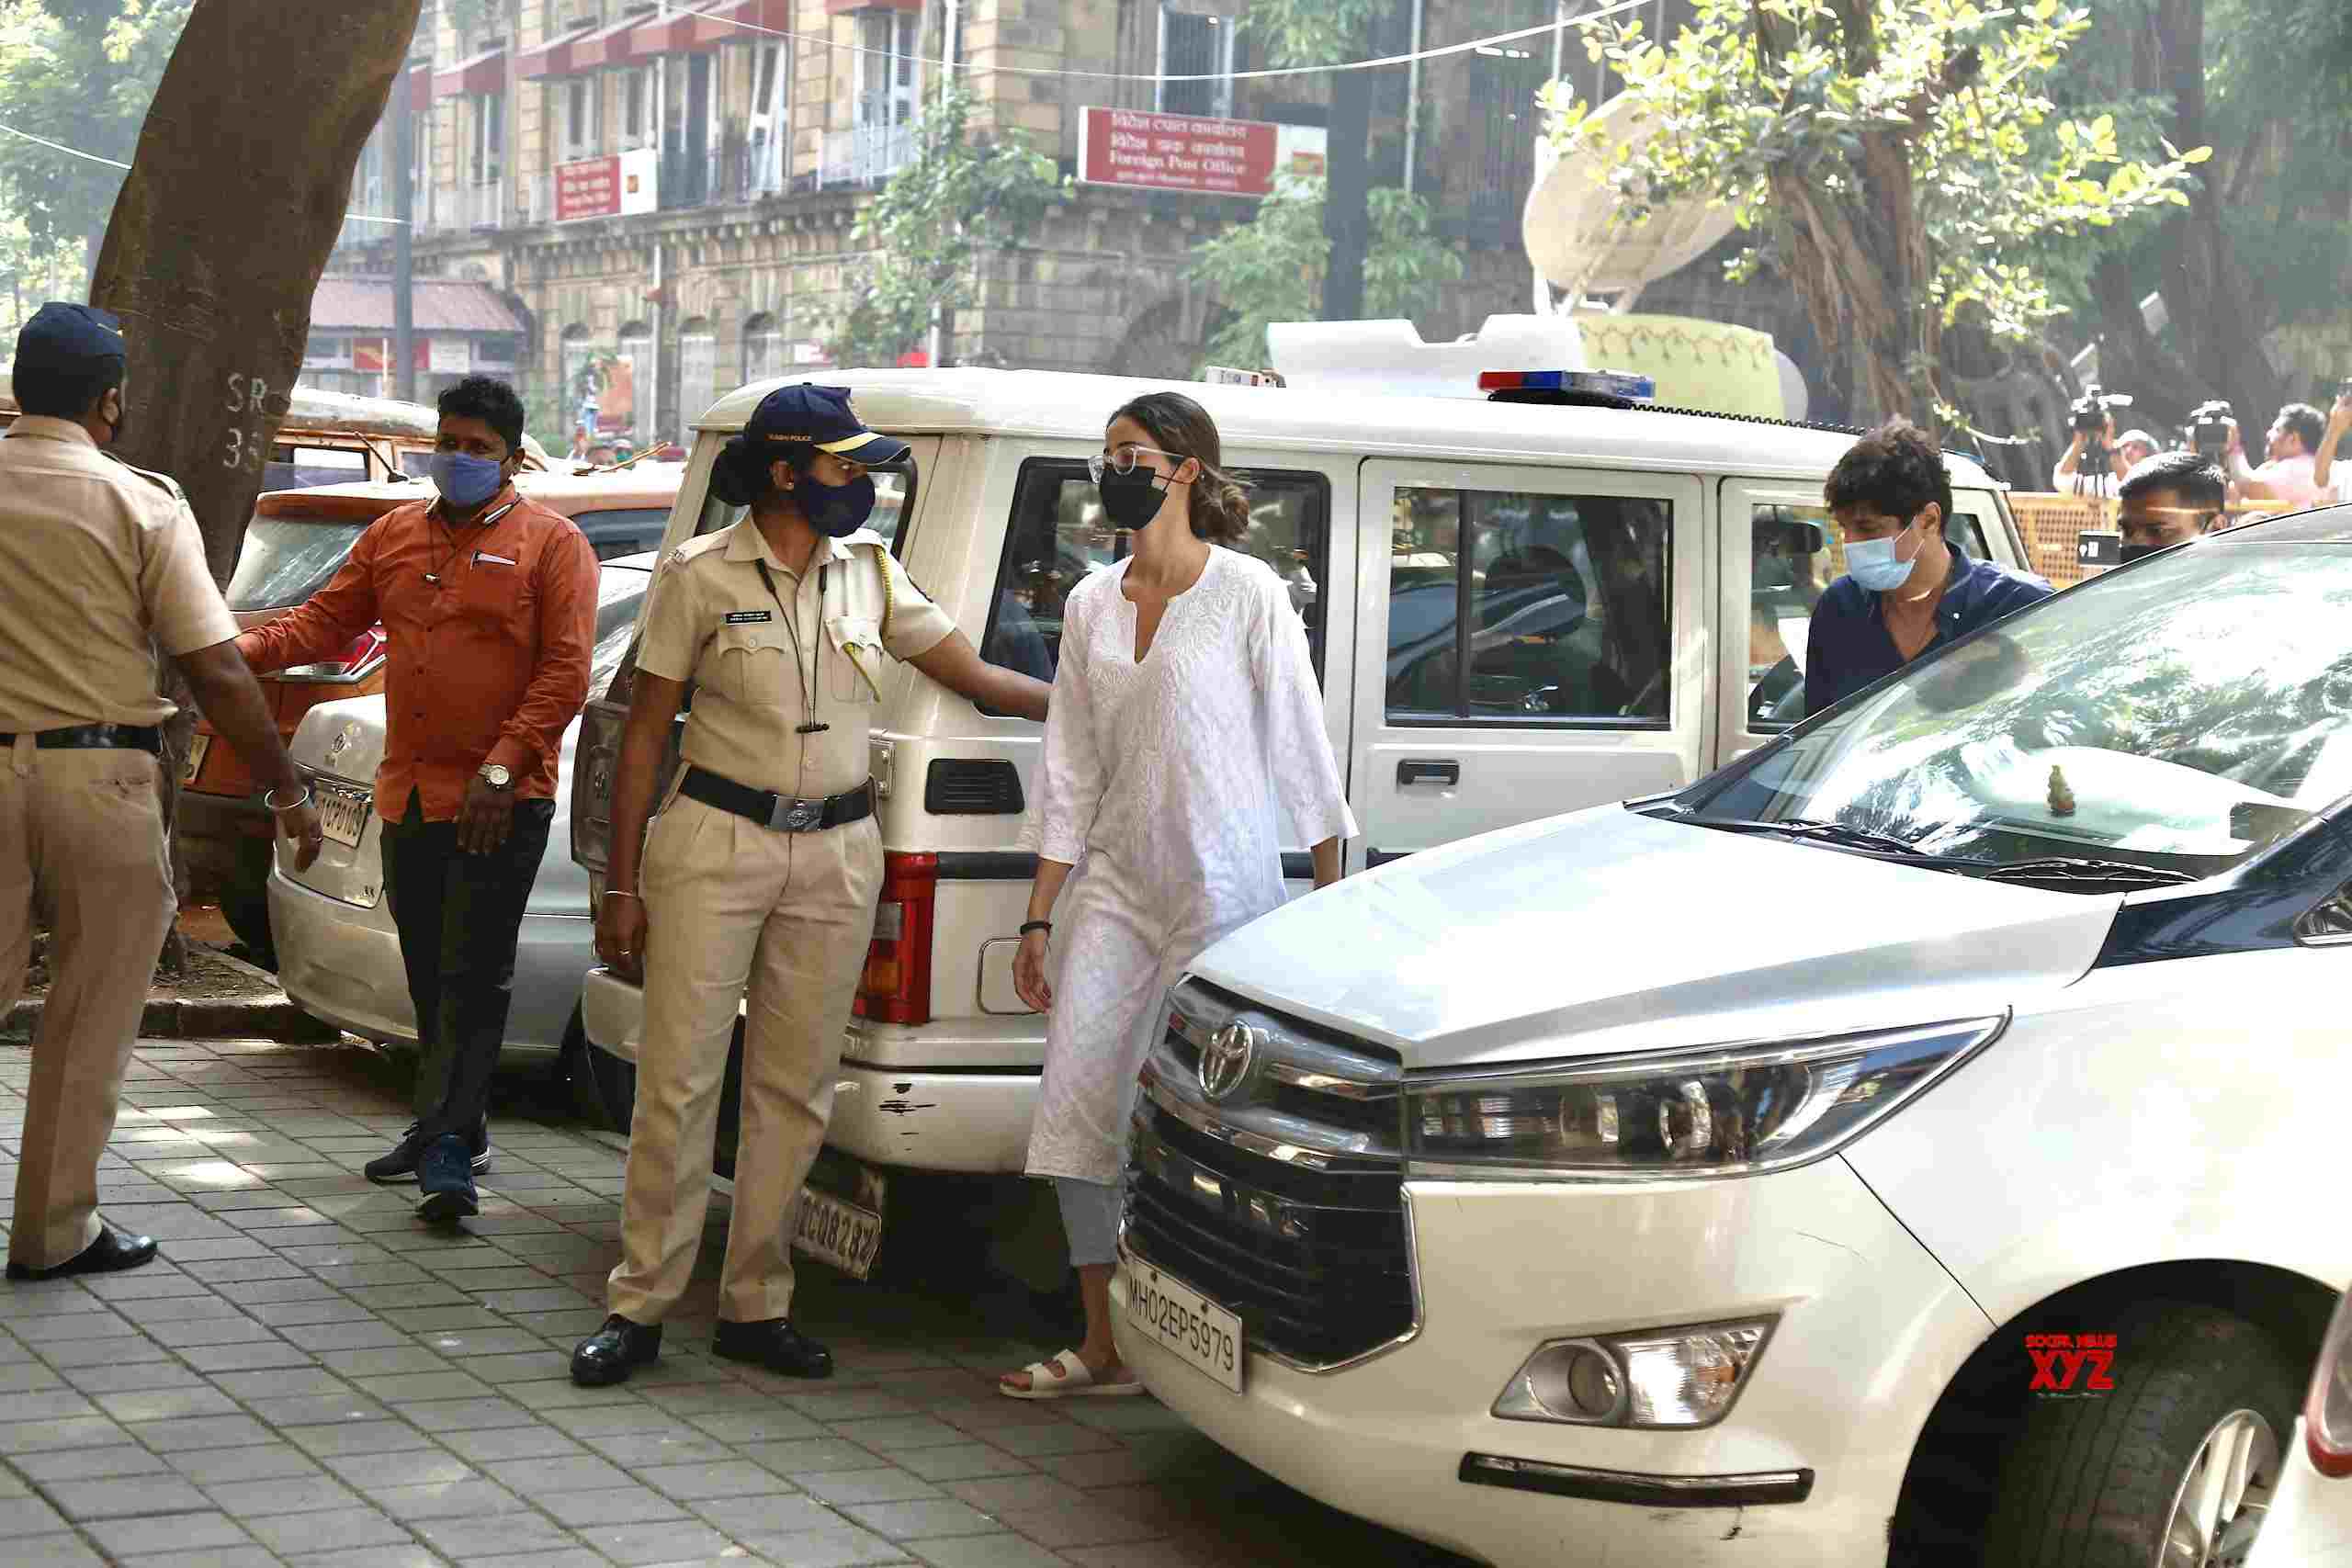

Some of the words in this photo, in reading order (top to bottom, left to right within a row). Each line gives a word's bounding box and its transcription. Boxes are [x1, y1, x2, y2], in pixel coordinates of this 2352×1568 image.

[1109, 149, 1164, 169] Foreign
[1168, 154, 1199, 169] Post
[1203, 157, 1248, 175] Office
[1129, 1277, 1234, 1371] MH02EP5979
